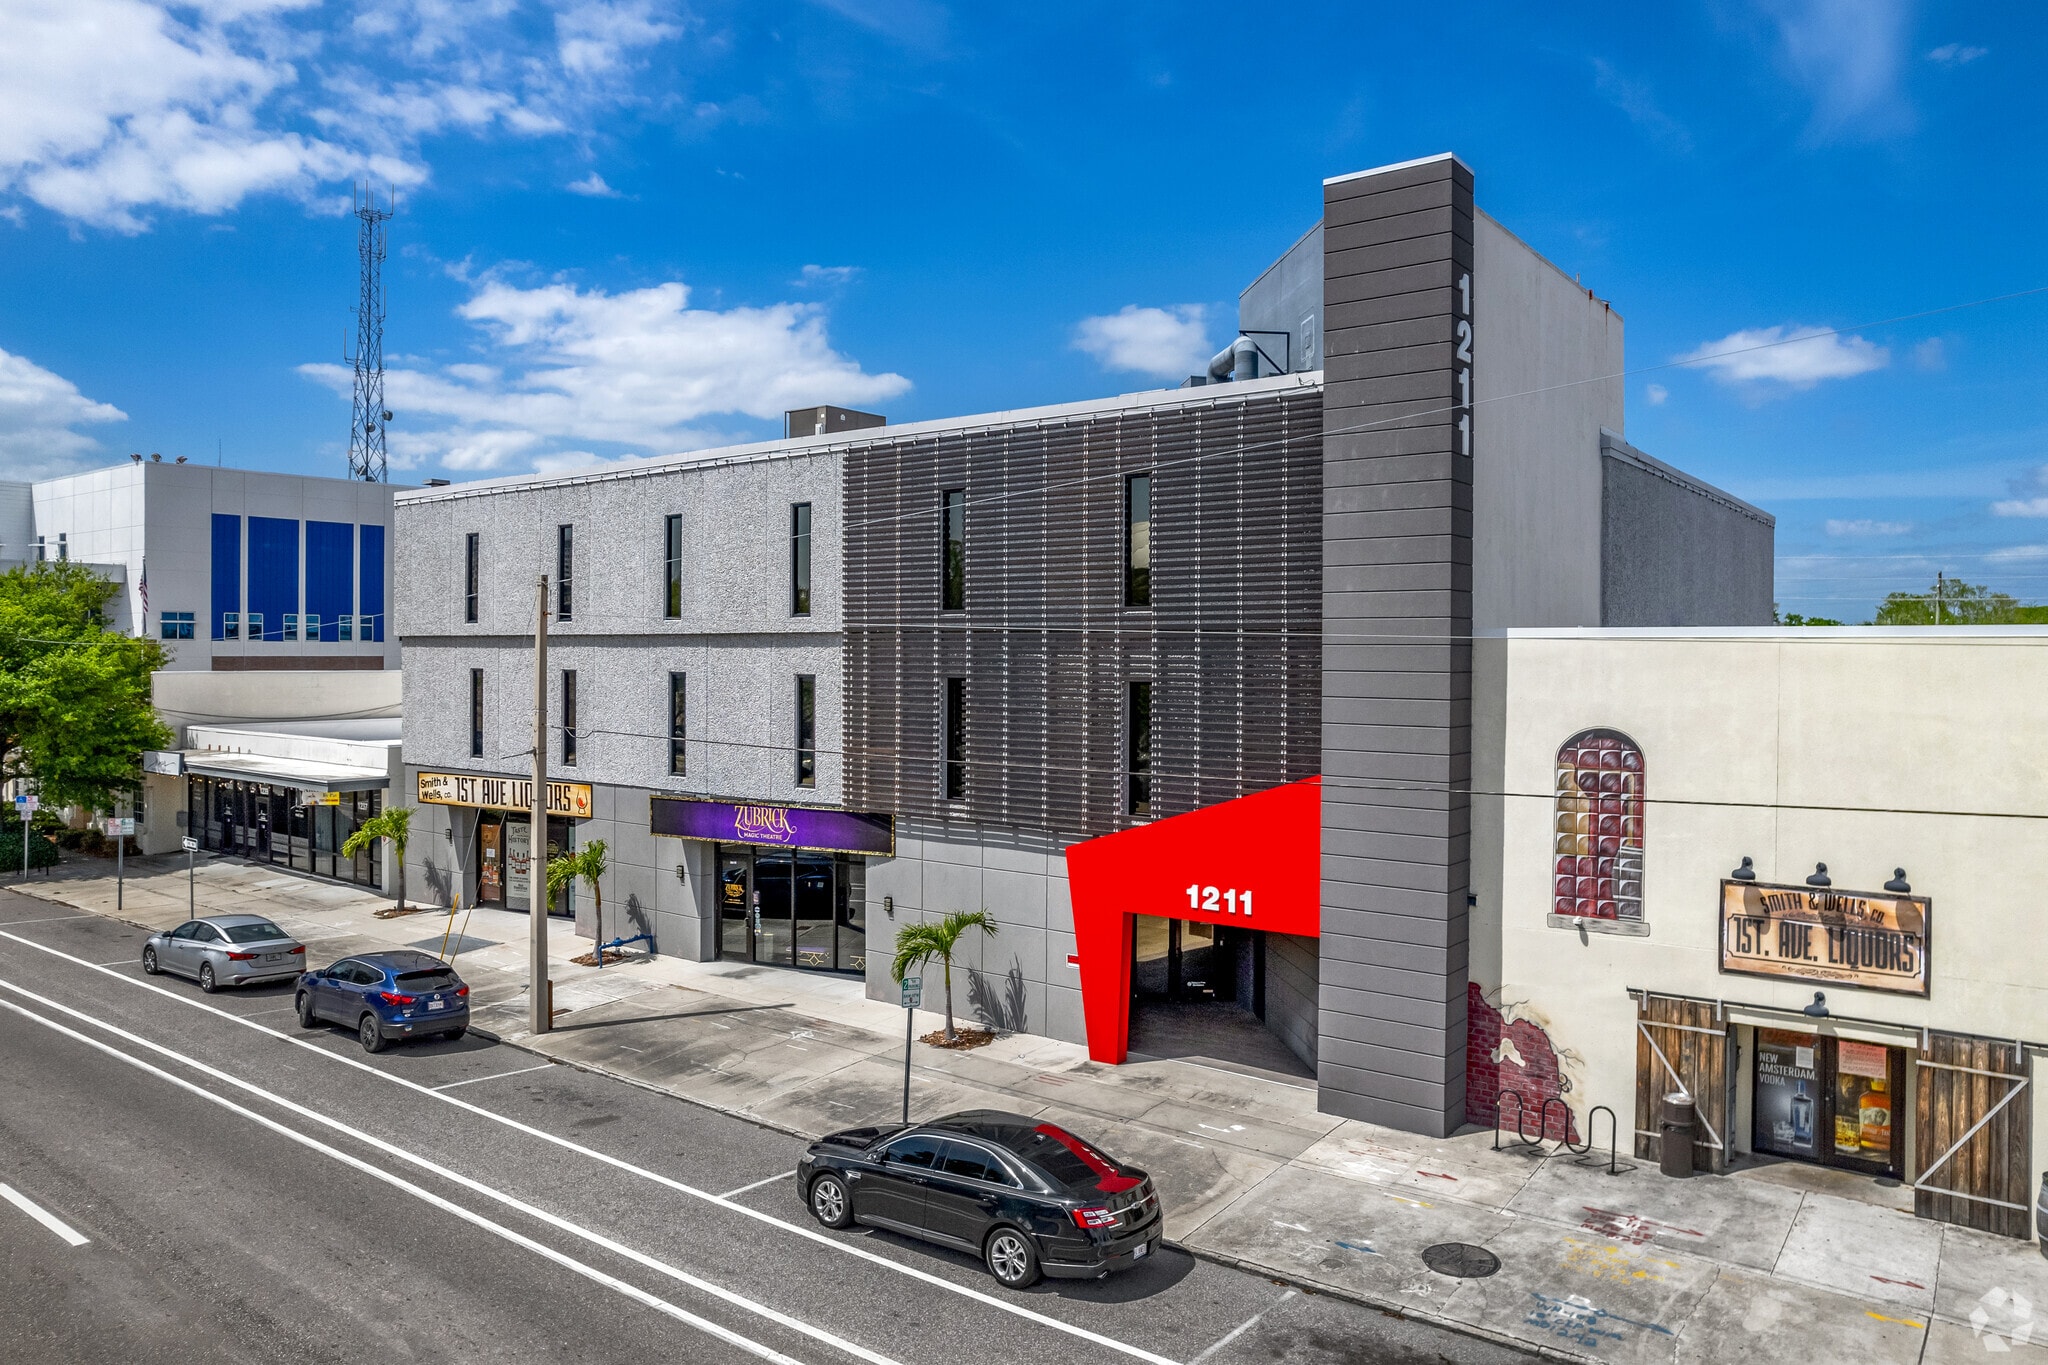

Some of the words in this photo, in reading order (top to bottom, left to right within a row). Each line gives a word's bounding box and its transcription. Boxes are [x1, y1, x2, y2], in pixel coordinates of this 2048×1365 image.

[1456, 273, 1472, 456] 1211
[420, 777, 441, 789] Smith
[442, 776, 449, 786] &
[454, 777, 477, 803] 1ST
[482, 779, 507, 806] AVE
[512, 781, 571, 811] LIQORS
[734, 805, 797, 834] ZUBRICK
[743, 831, 760, 839] MAGIC
[760, 833, 783, 841] THEATRE
[1186, 884, 1252, 916] 1211
[1760, 892, 1802, 914] SMITH
[1808, 892, 1819, 911] &
[1823, 893, 1868, 916] WELLS
[1870, 908, 1885, 925] CO.
[1734, 916, 1769, 957] 1ST.
[1778, 921, 1819, 962] AVE.
[1828, 924, 1914, 974] LIQUORS
[1759, 1051, 1779, 1064] NEW
[1759, 1062, 1816, 1080] AMSTERDAM
[1759, 1073, 1786, 1087] VODKA
